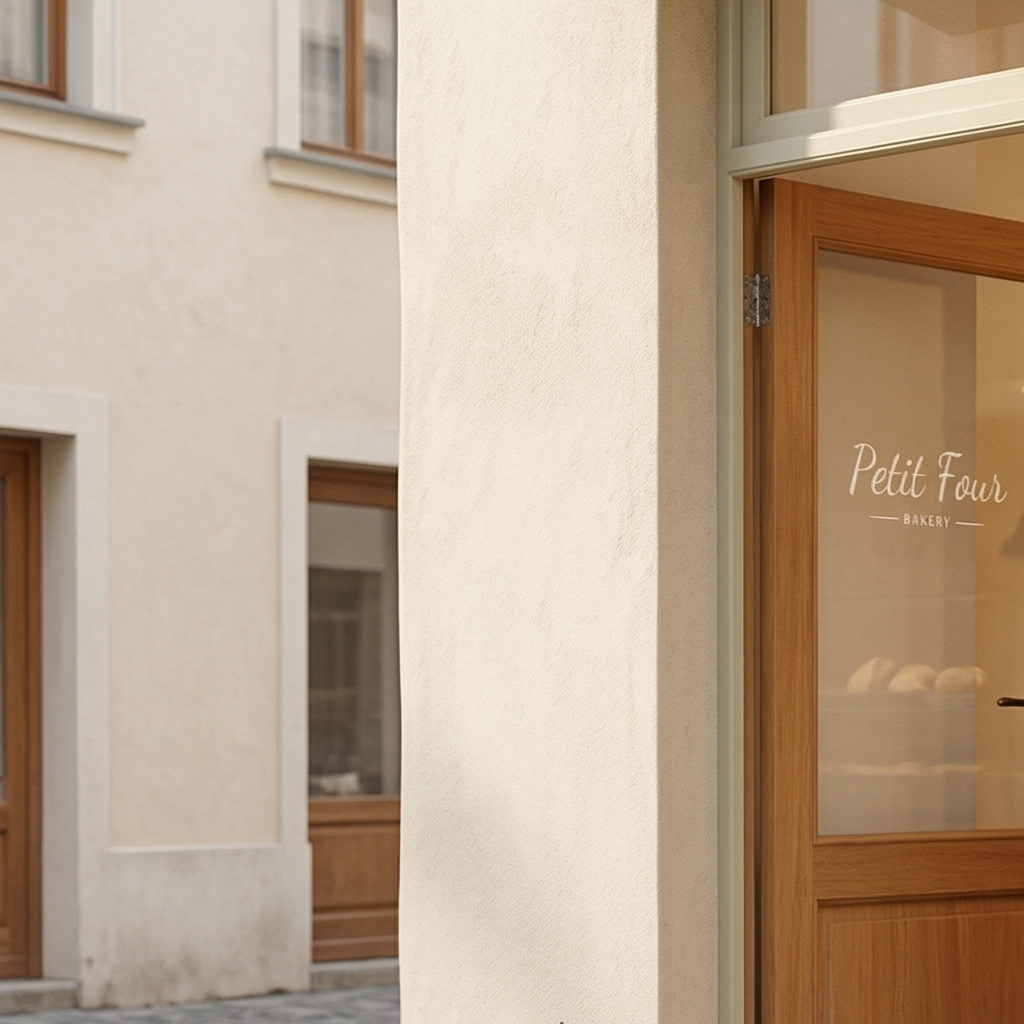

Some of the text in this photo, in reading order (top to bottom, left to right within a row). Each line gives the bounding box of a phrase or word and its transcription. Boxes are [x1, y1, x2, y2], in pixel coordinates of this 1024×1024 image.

[849, 443, 1007, 503] Petit Four
[903, 513, 951, 527] BAKERY
